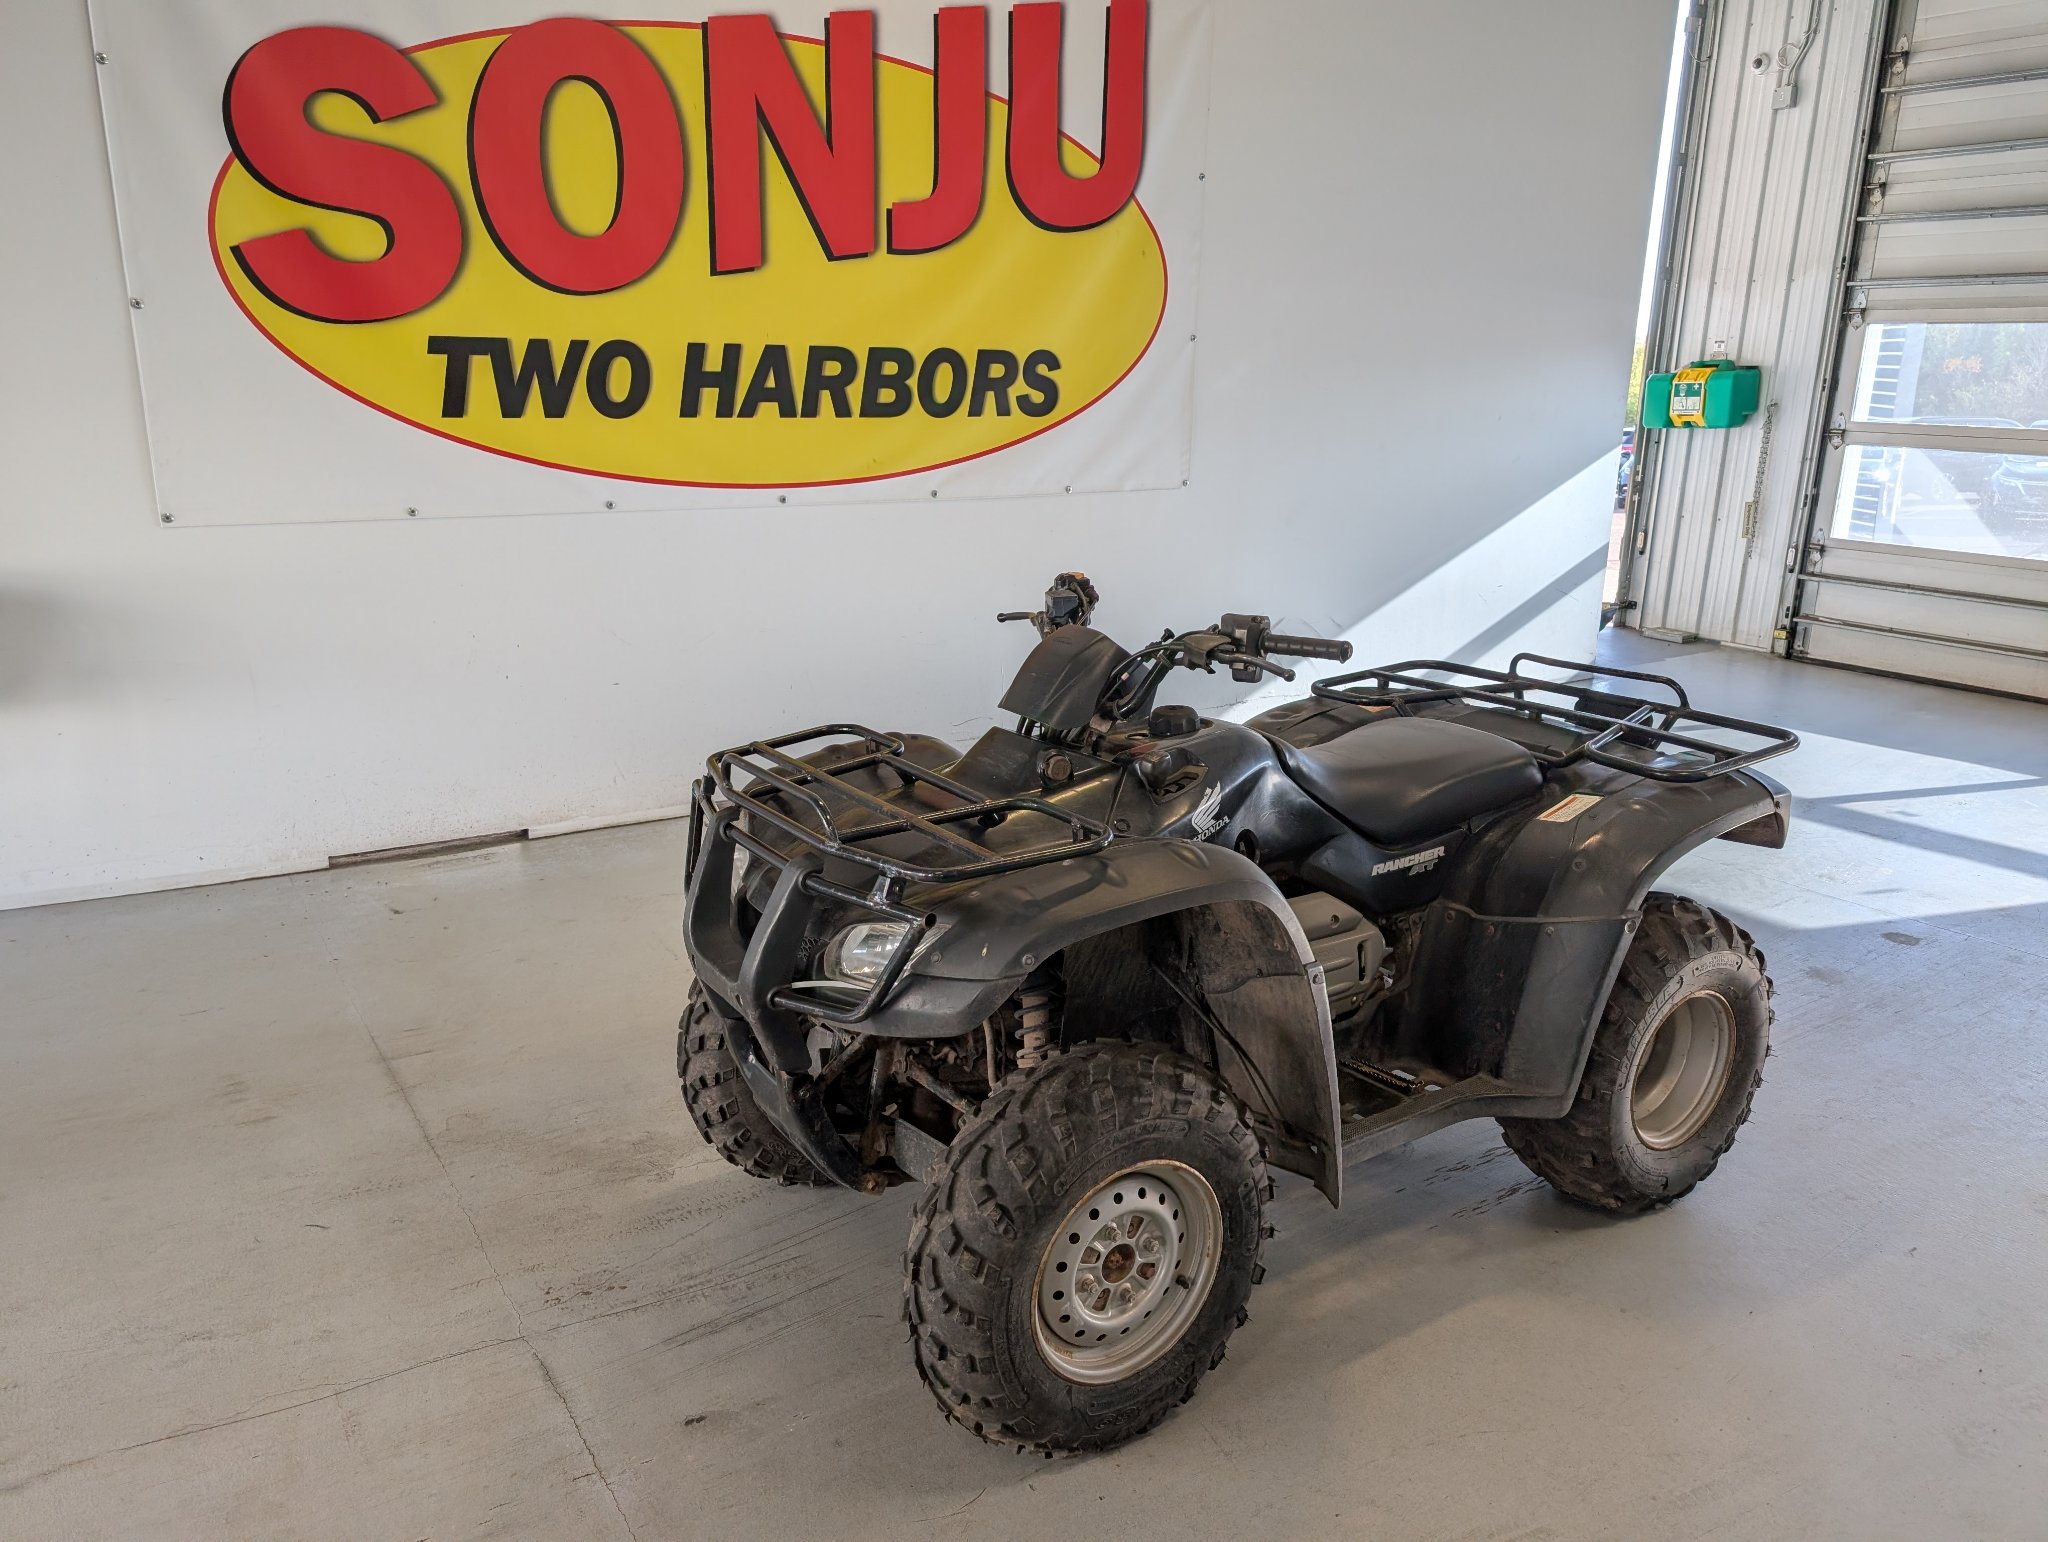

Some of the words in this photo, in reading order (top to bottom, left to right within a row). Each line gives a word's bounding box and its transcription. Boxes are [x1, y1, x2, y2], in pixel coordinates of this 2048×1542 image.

[223, 0, 1149, 324] SONJU
[427, 335, 651, 420] TWO
[680, 345, 1061, 419] HARBORS
[1192, 815, 1230, 841] HONDA
[1371, 845, 1446, 876] RANCHER
[1408, 859, 1438, 876] AT
